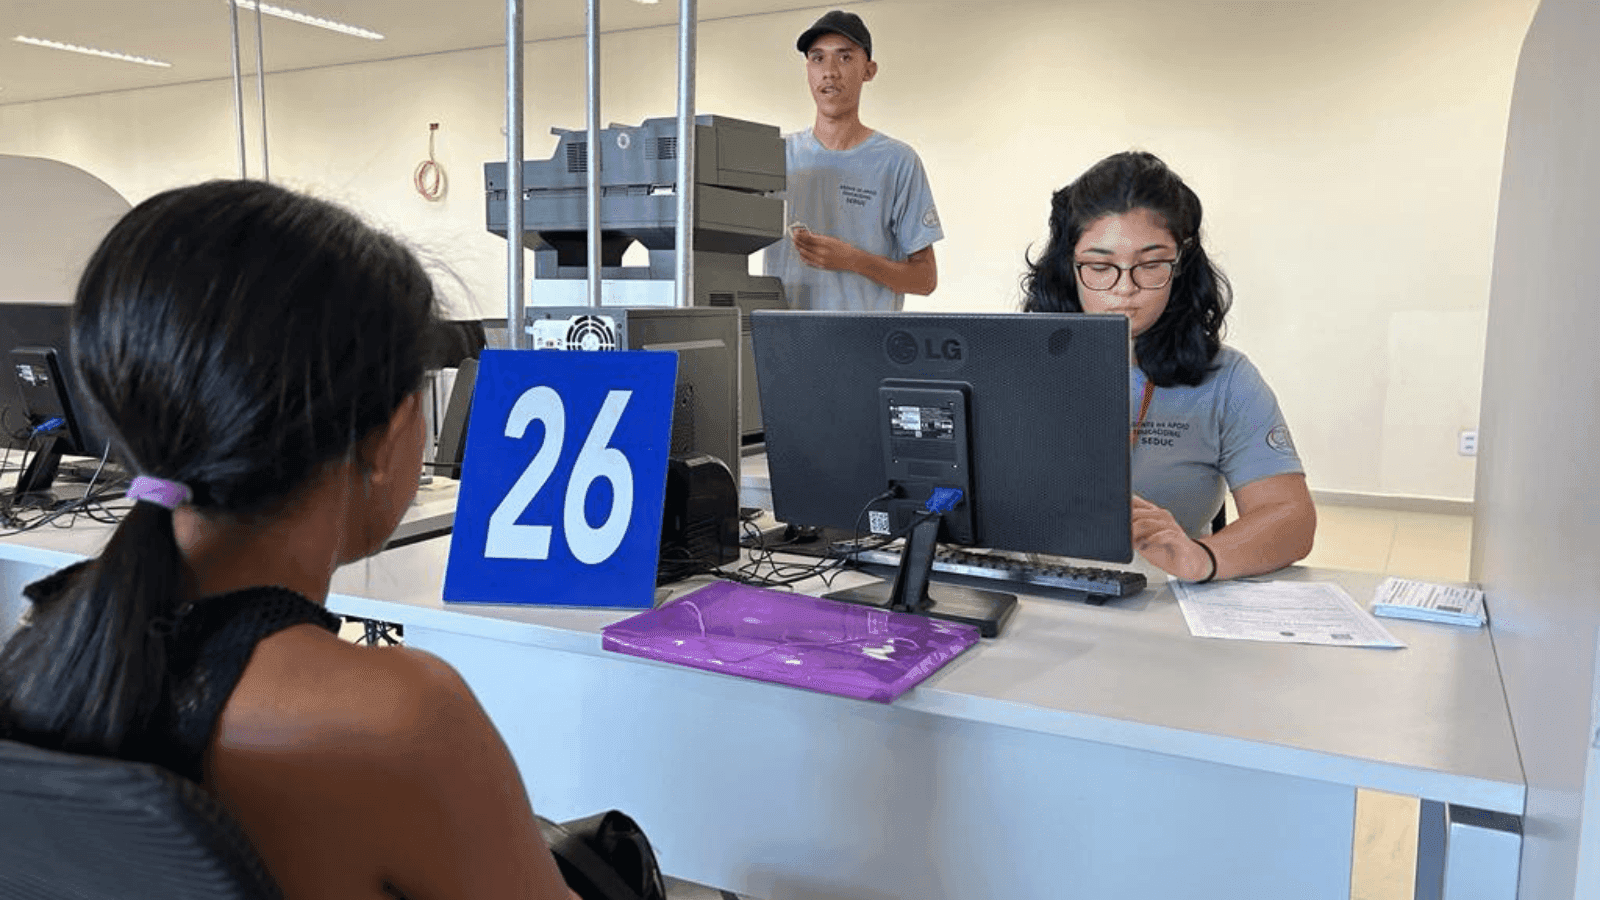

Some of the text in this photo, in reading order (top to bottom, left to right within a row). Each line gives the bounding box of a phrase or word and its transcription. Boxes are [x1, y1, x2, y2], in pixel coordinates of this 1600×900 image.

[924, 338, 962, 361] LG
[1141, 437, 1174, 447] SEDUC
[483, 385, 634, 565] 26
